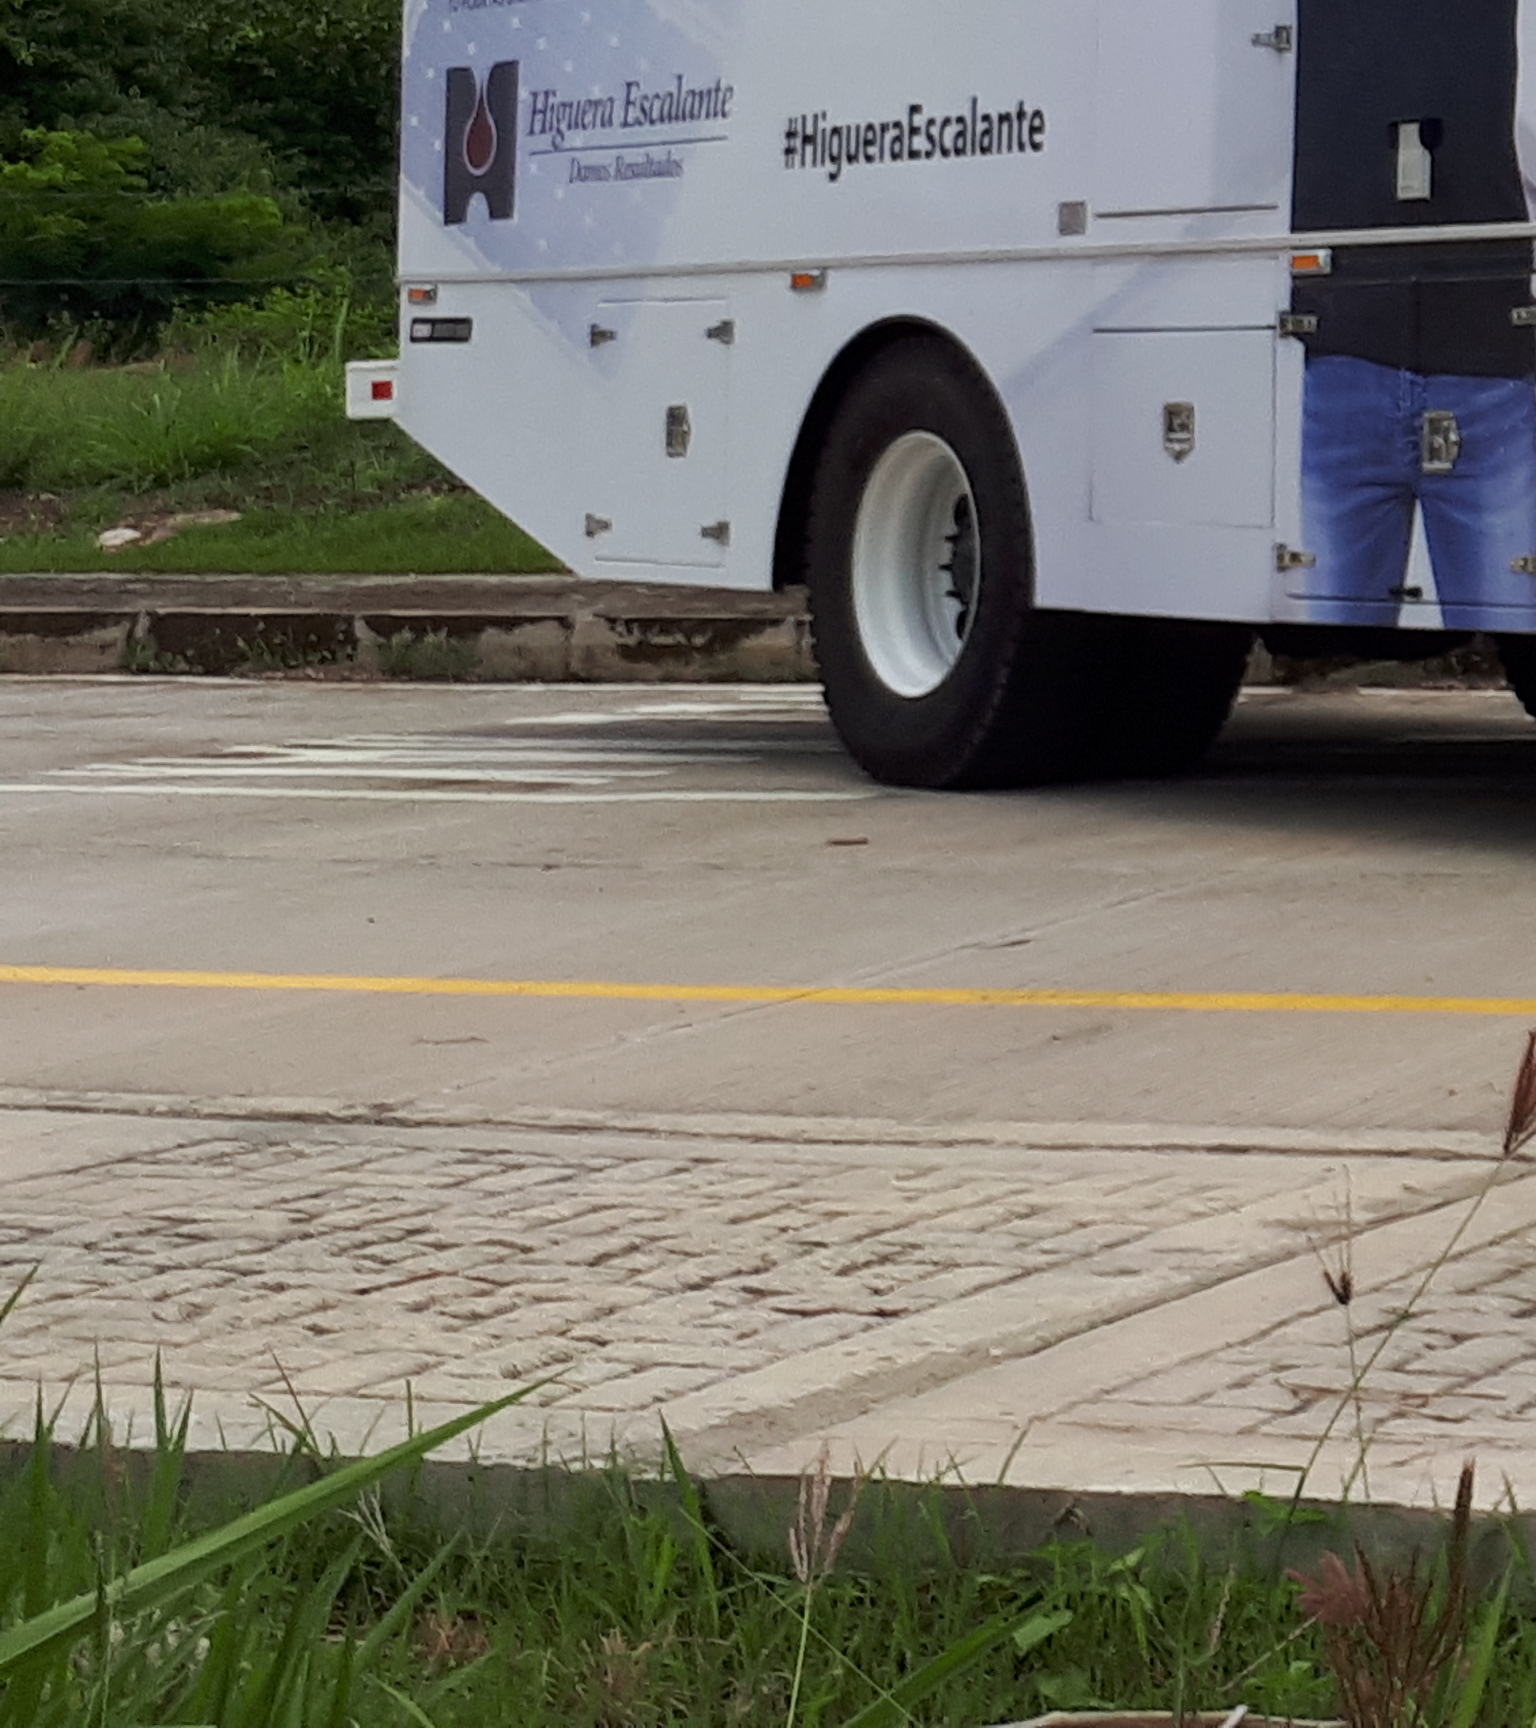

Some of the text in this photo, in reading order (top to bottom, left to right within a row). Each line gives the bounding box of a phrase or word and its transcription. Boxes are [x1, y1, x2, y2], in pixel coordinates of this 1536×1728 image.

[526, 74, 734, 150] Higuera Escalante
[784, 95, 1046, 183] #HigueraEscalante
